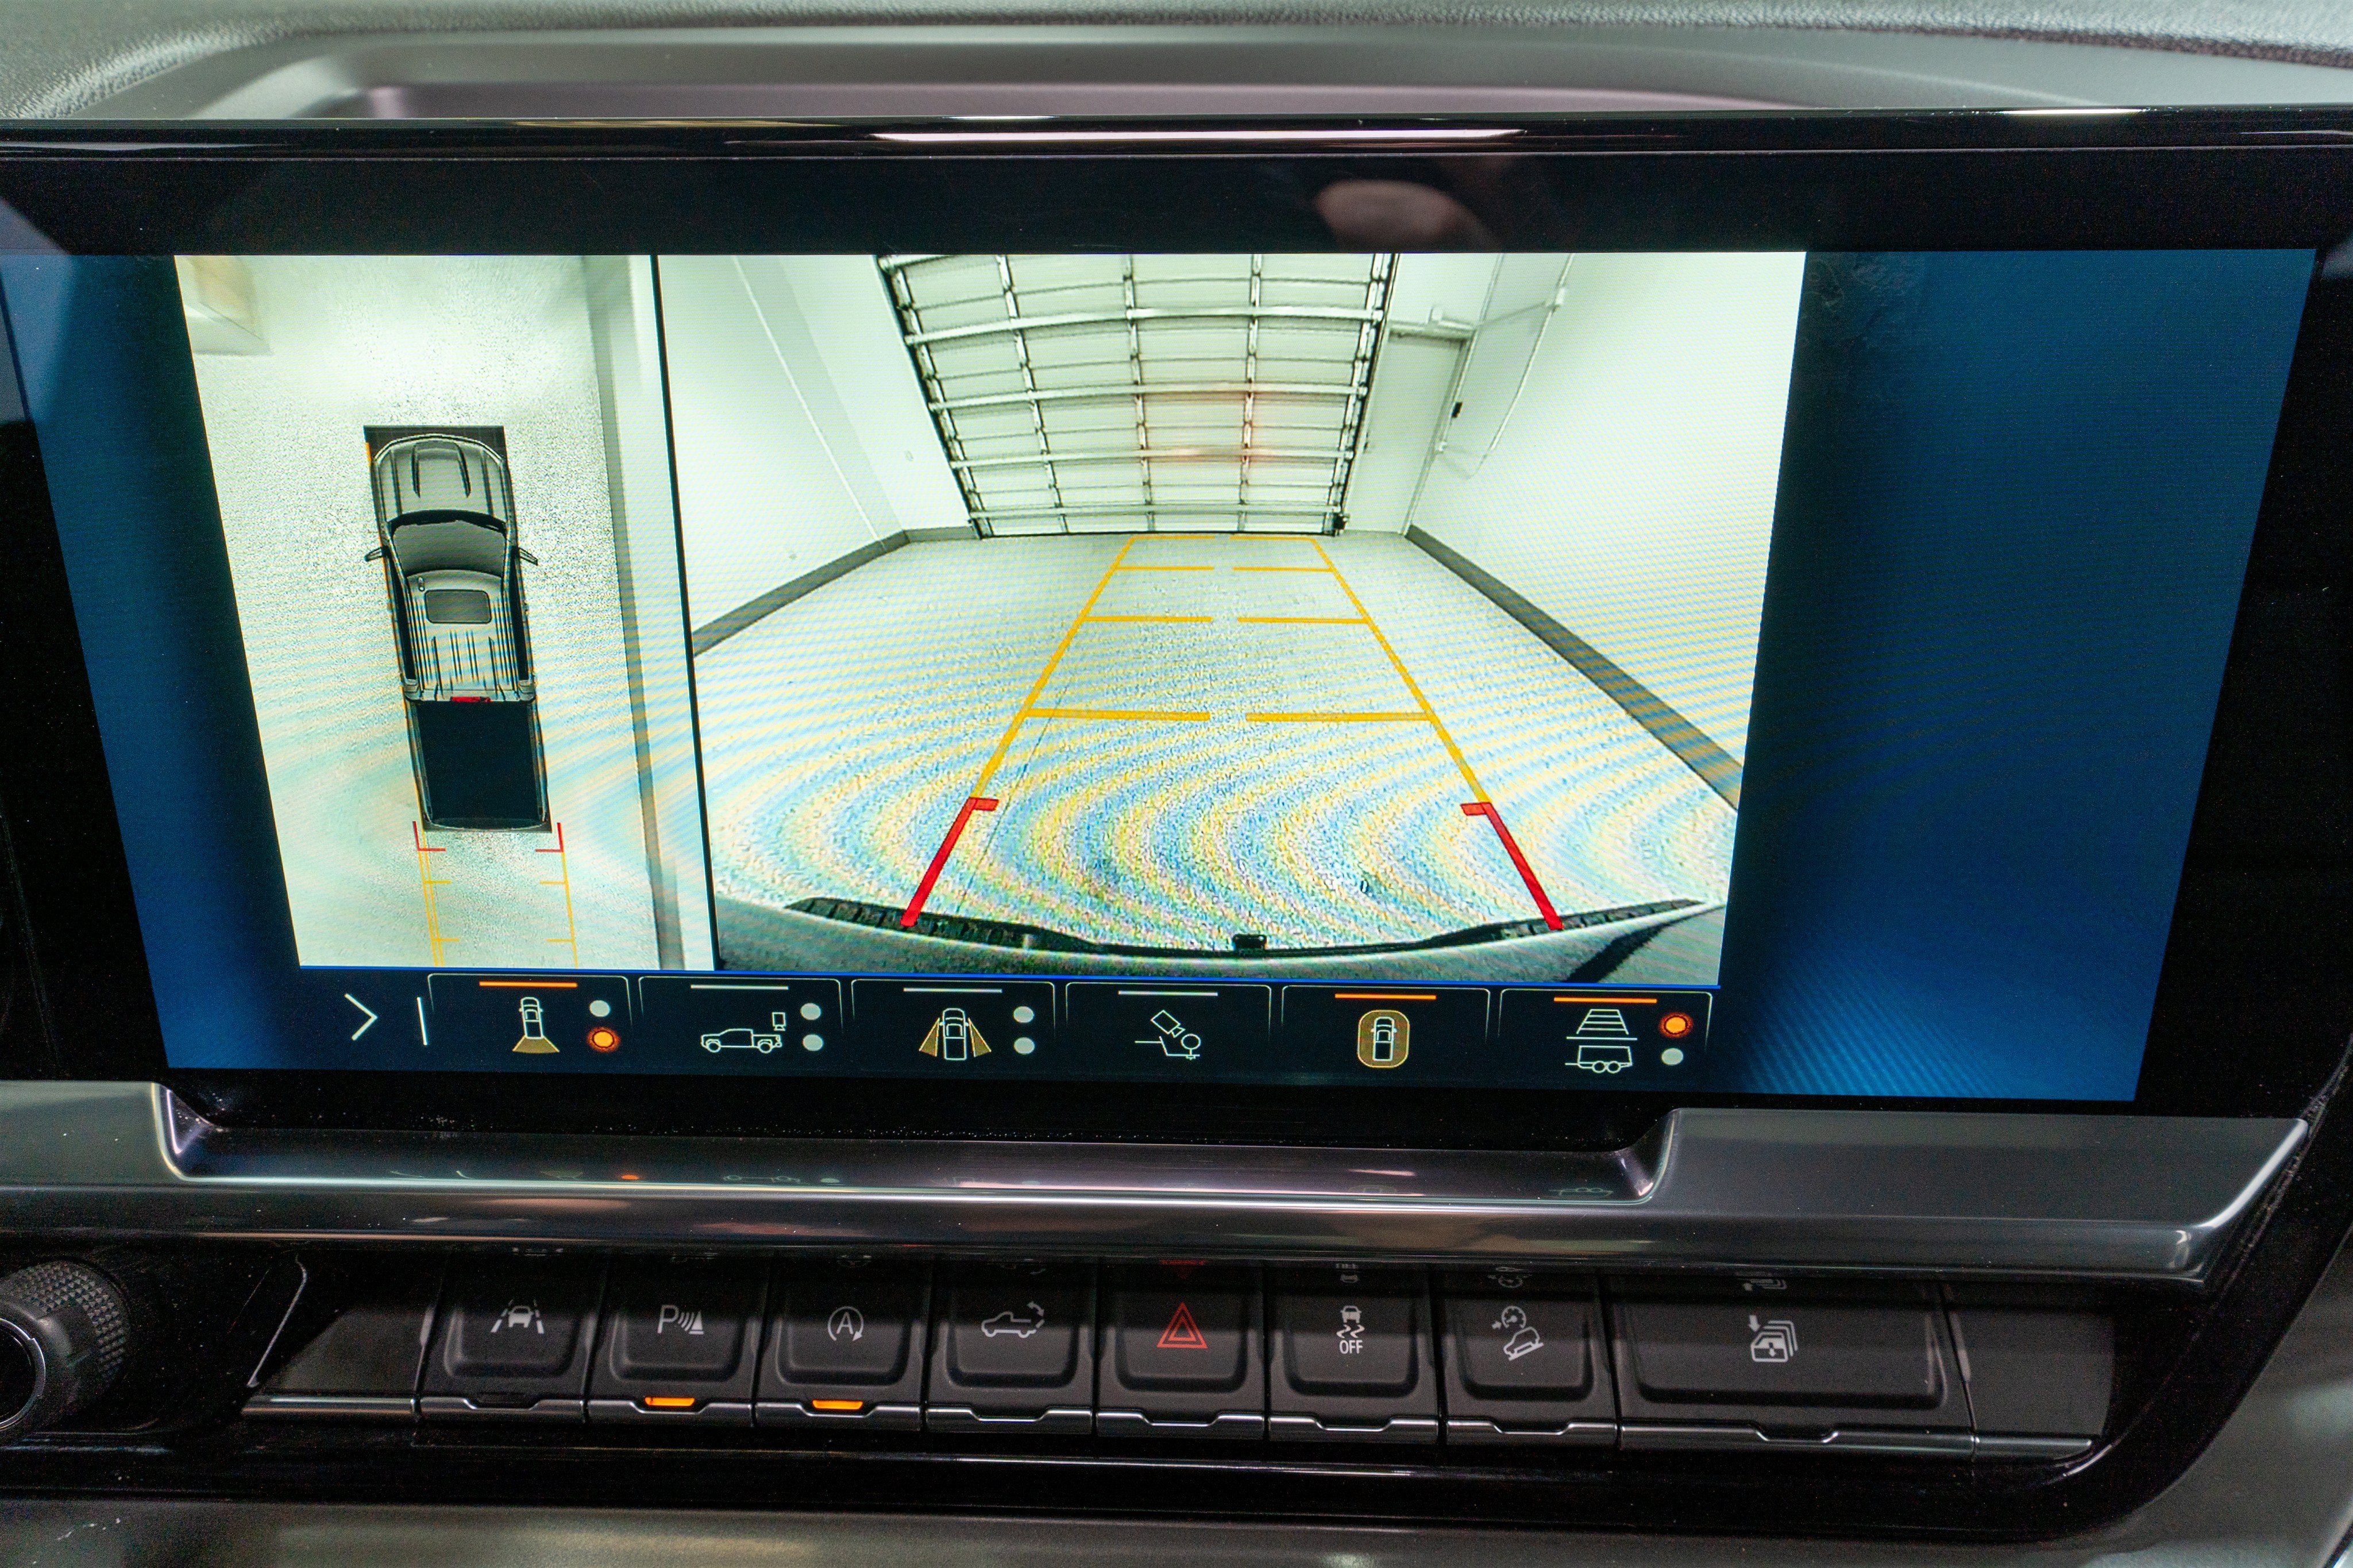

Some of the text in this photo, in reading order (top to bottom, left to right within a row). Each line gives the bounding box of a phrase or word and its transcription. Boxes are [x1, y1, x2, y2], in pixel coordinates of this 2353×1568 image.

[657, 1304, 679, 1334] P
[836, 1312, 854, 1335] A
[1339, 1339, 1363, 1354] OFF
